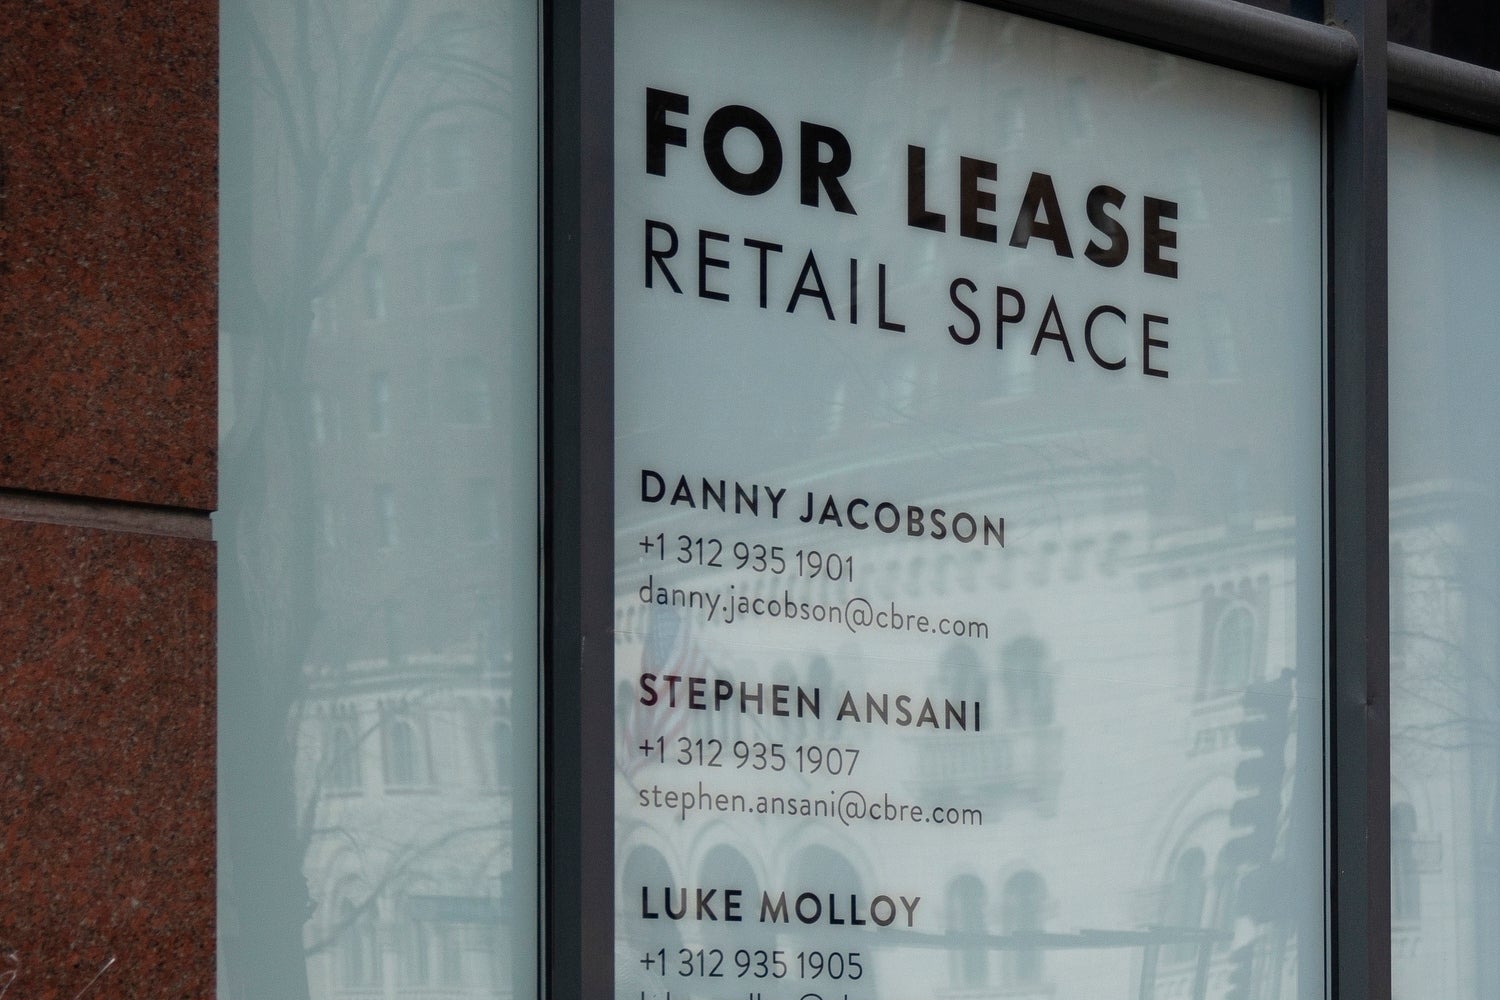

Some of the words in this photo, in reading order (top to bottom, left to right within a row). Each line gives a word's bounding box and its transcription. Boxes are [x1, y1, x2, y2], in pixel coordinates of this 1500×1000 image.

[646, 87, 857, 215] FOR
[907, 144, 1178, 279] LEASE
[645, 219, 906, 333] RETAIL
[948, 278, 1168, 379] SPACE
[641, 469, 787, 519] DANNY
[800, 491, 1005, 548] JACOBSON
[639, 533, 665, 560] +1
[677, 535, 722, 567] 312
[733, 542, 786, 575] 935
[795, 550, 854, 582] 1901
[639, 575, 989, 639] danny.jacobson@cbre.com
[640, 673, 820, 719] STEPHEN
[837, 691, 981, 731] ANSANI
[639, 736, 665, 763] +1
[677, 737, 722, 768] 312
[733, 741, 786, 771] 935
[795, 746, 860, 776] 1907
[639, 782, 982, 826] stephen.ansani@cbre.com
[641, 886, 743, 922] LUKE
[760, 890, 921, 927] MOLLOY
[640, 948, 666, 976] +1
[678, 948, 724, 978] 312
[735, 950, 787, 979] 935
[797, 952, 863, 980] 1905
